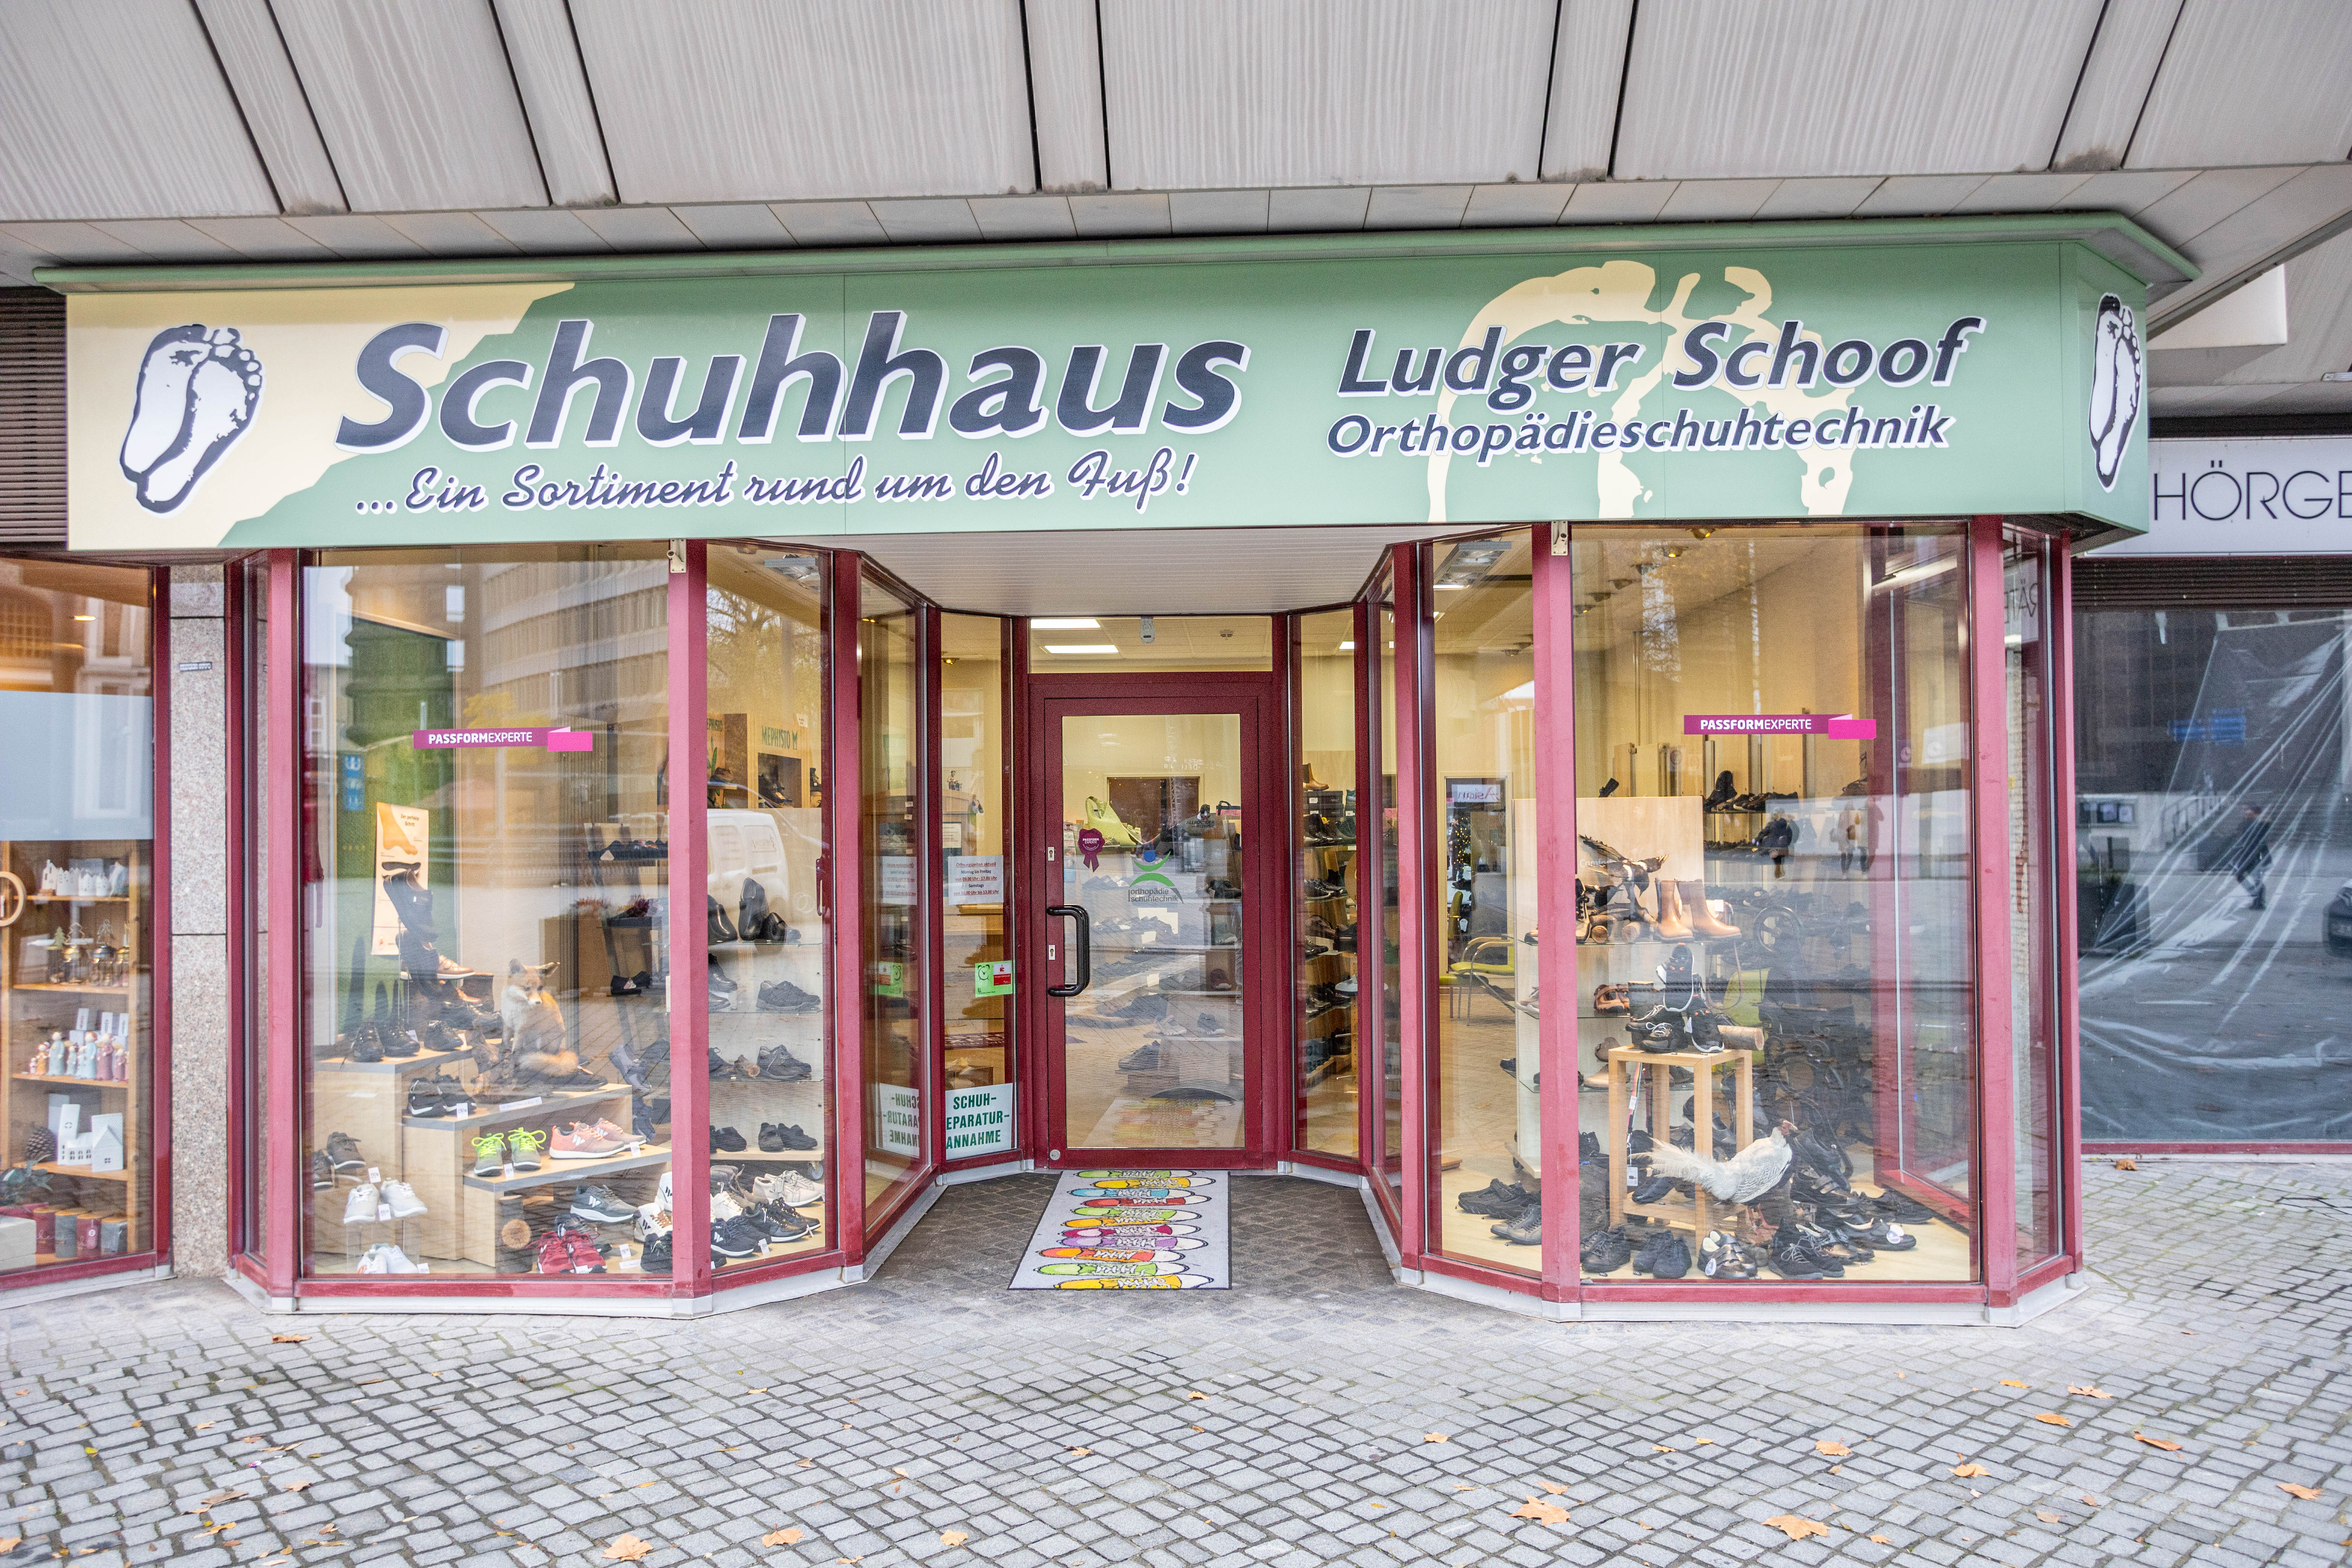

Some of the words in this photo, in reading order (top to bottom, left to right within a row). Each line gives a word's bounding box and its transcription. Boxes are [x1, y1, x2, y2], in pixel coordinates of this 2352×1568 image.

[1337, 325, 1646, 415] Ludger
[1672, 315, 1987, 390] Schoof
[335, 309, 1251, 454] Schuhhaus
[1327, 404, 1956, 467] Orthopädieschuhtechnik
[501, 459, 738, 511] Sortiment
[742, 454, 866, 507] rund
[874, 470, 956, 503] um
[963, 450, 1055, 500] den
[1066, 446, 1199, 514] Fuß!
[1700, 719, 1811, 730] PASSFORMEXPERTE
[429, 732, 533, 744] PASSFORMEXPERTE
[761, 726, 790, 749] MEPHISTO
[1130, 888, 1169, 896] orthopädie
[953, 1093, 997, 1110] SCHUH-
[946, 1110, 1010, 1130] EPARATUR-
[946, 1130, 1001, 1149] ANNAHME
